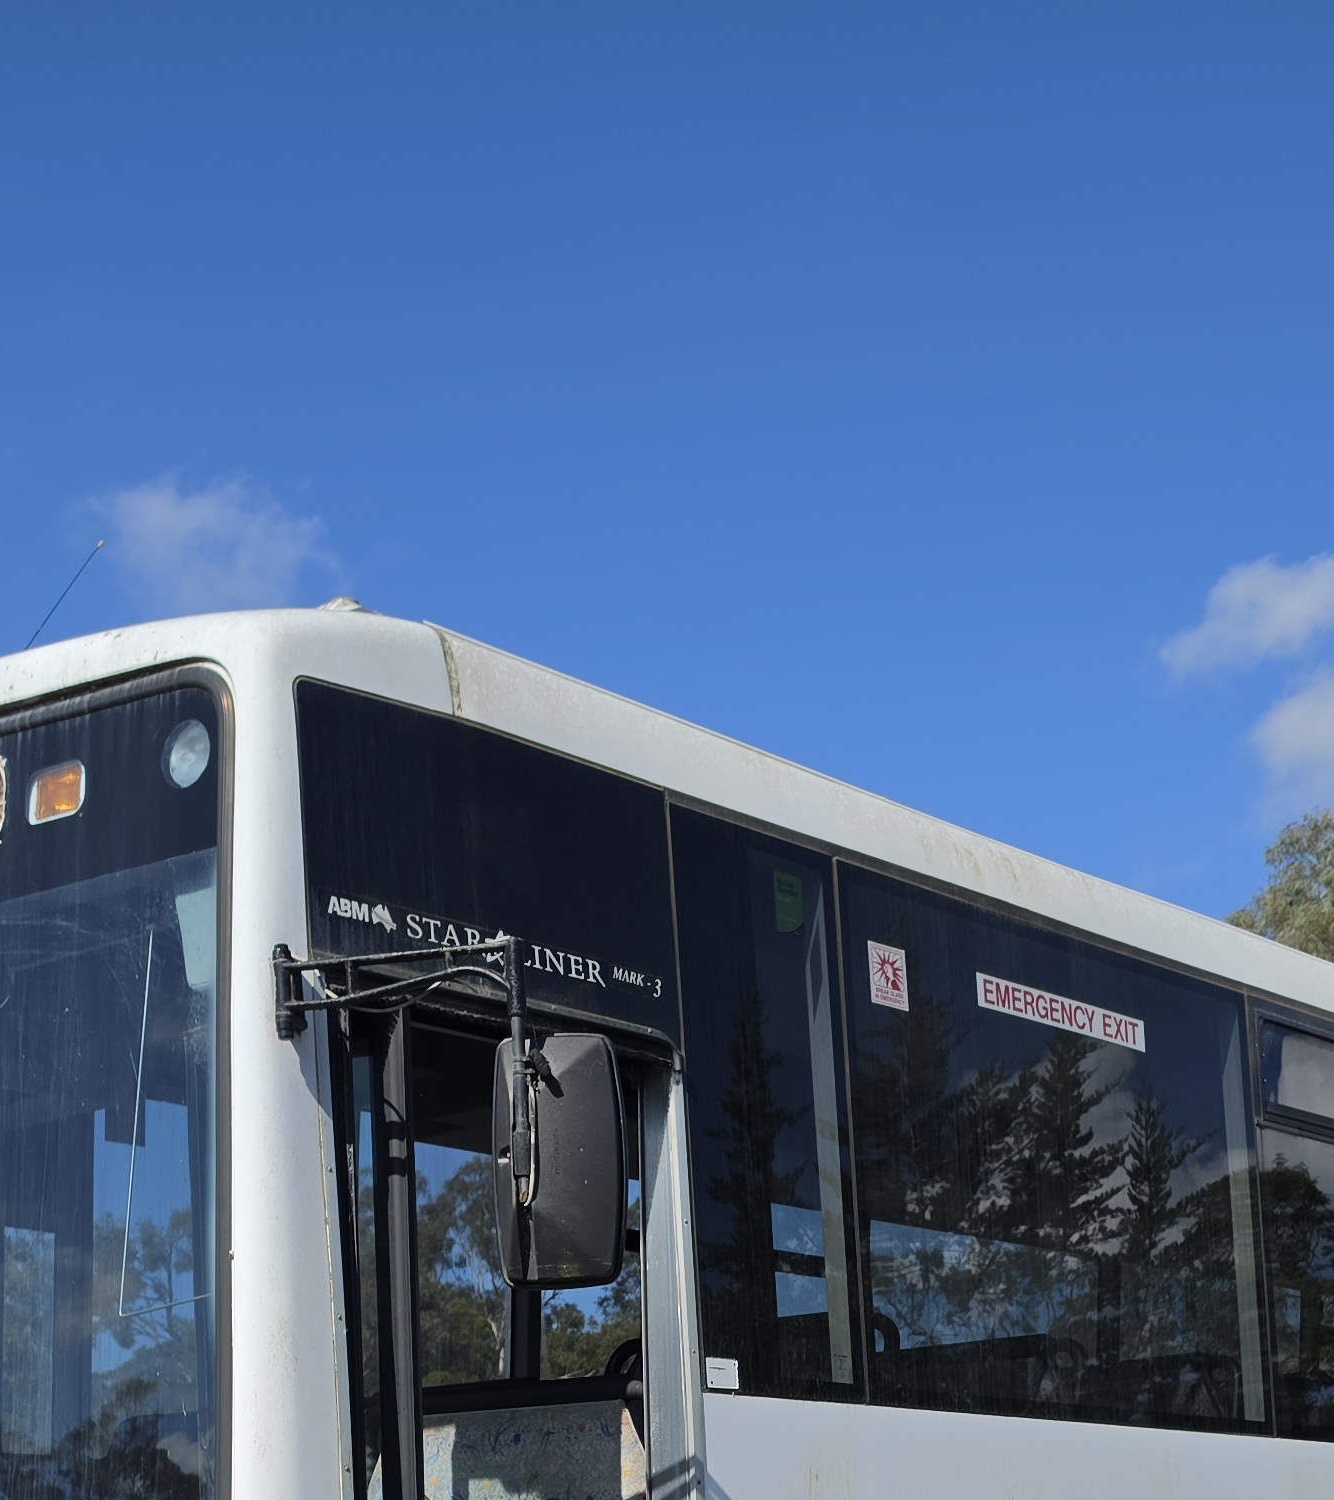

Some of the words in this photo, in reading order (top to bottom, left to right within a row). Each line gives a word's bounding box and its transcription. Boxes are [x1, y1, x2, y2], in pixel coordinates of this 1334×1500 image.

[327, 895, 370, 923] ABM
[524, 944, 607, 988] INER
[983, 978, 1095, 1034] EMERGENCY
[1102, 1014, 1140, 1047] EXIT
